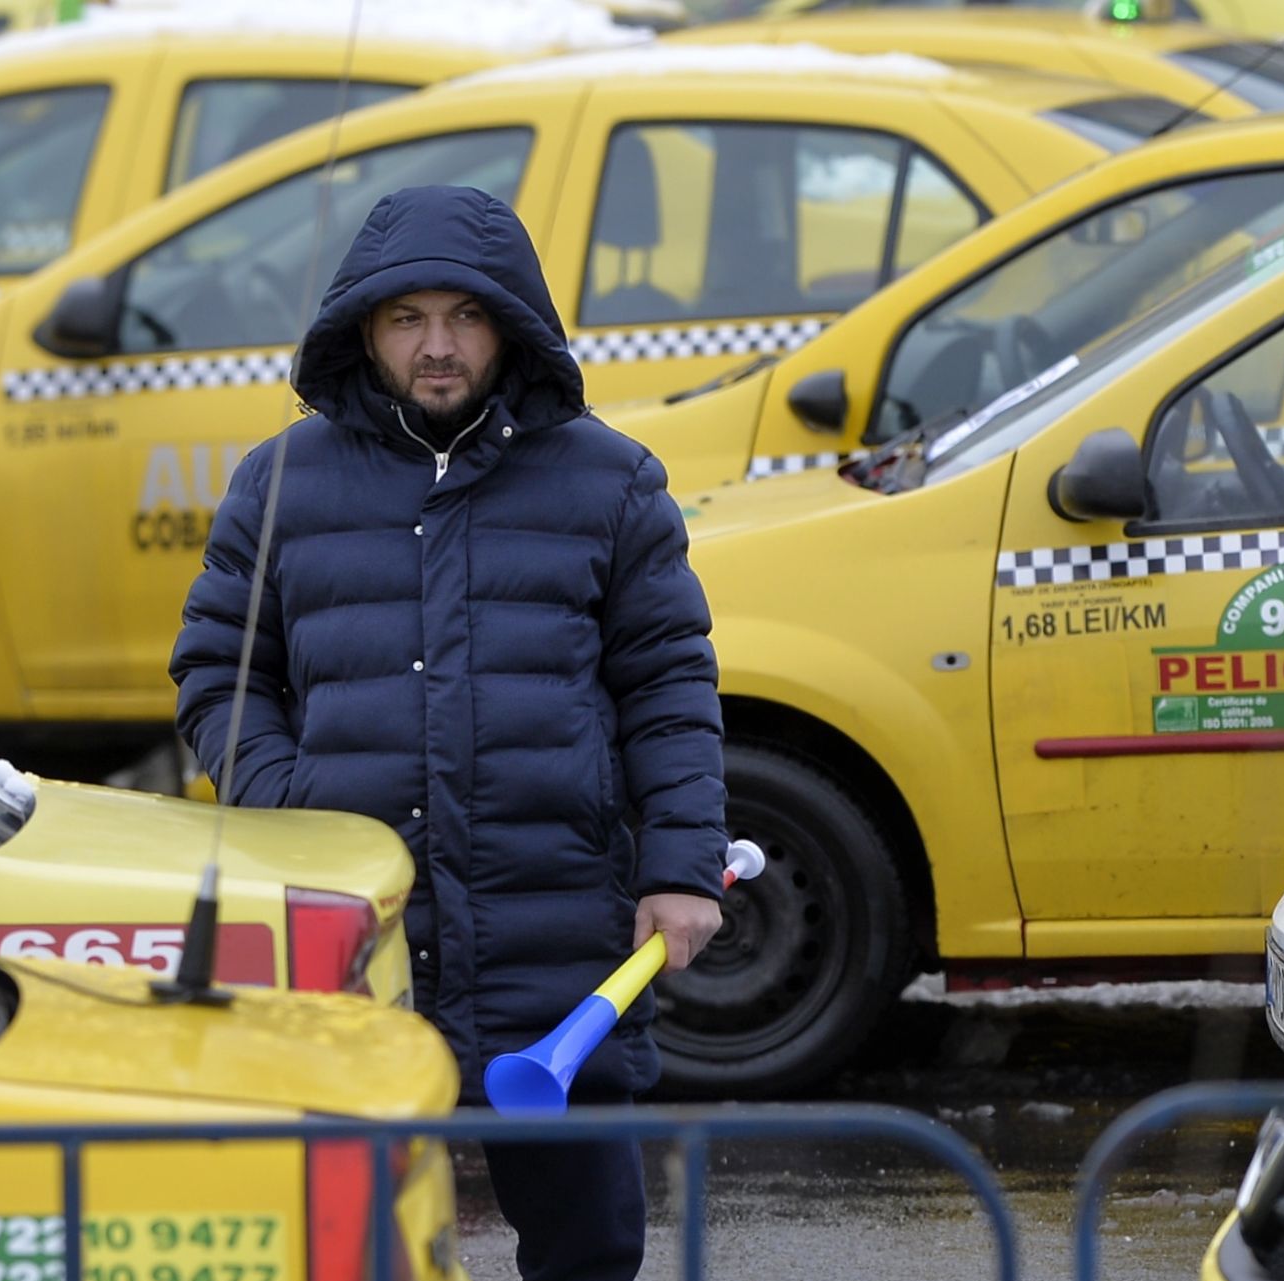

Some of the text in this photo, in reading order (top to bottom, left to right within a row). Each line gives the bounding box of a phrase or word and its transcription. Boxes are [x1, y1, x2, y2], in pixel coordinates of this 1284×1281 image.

[1002, 603, 1167, 646] 1,68 LEI/KM
[150, 1217, 278, 1252] 9477
